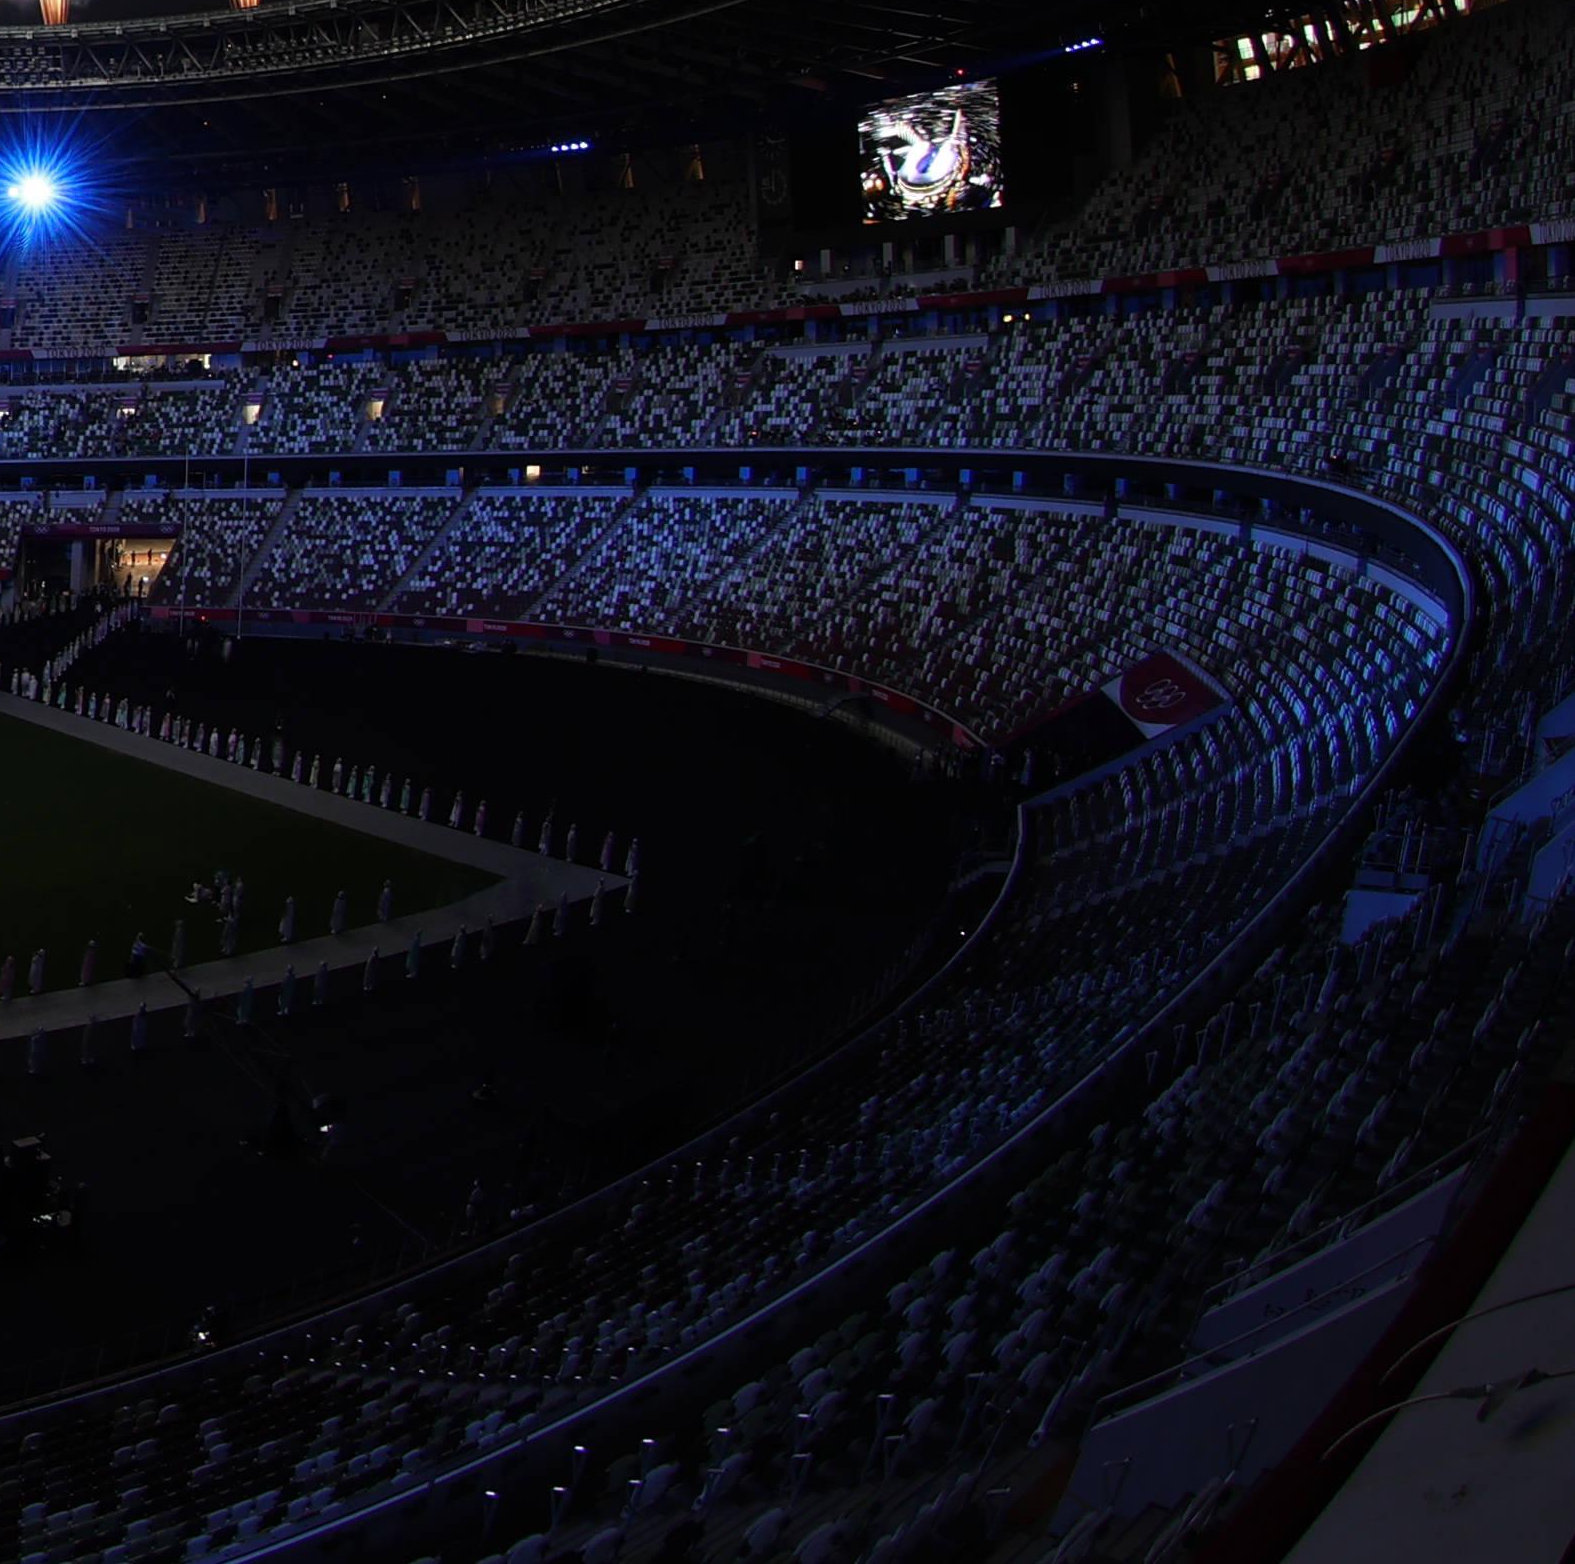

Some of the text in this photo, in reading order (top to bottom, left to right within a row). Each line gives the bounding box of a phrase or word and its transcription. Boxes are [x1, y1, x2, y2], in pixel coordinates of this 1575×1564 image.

[256, 339, 313, 351] TOKYO 2020
[47, 347, 105, 358] TOKYO 2020
